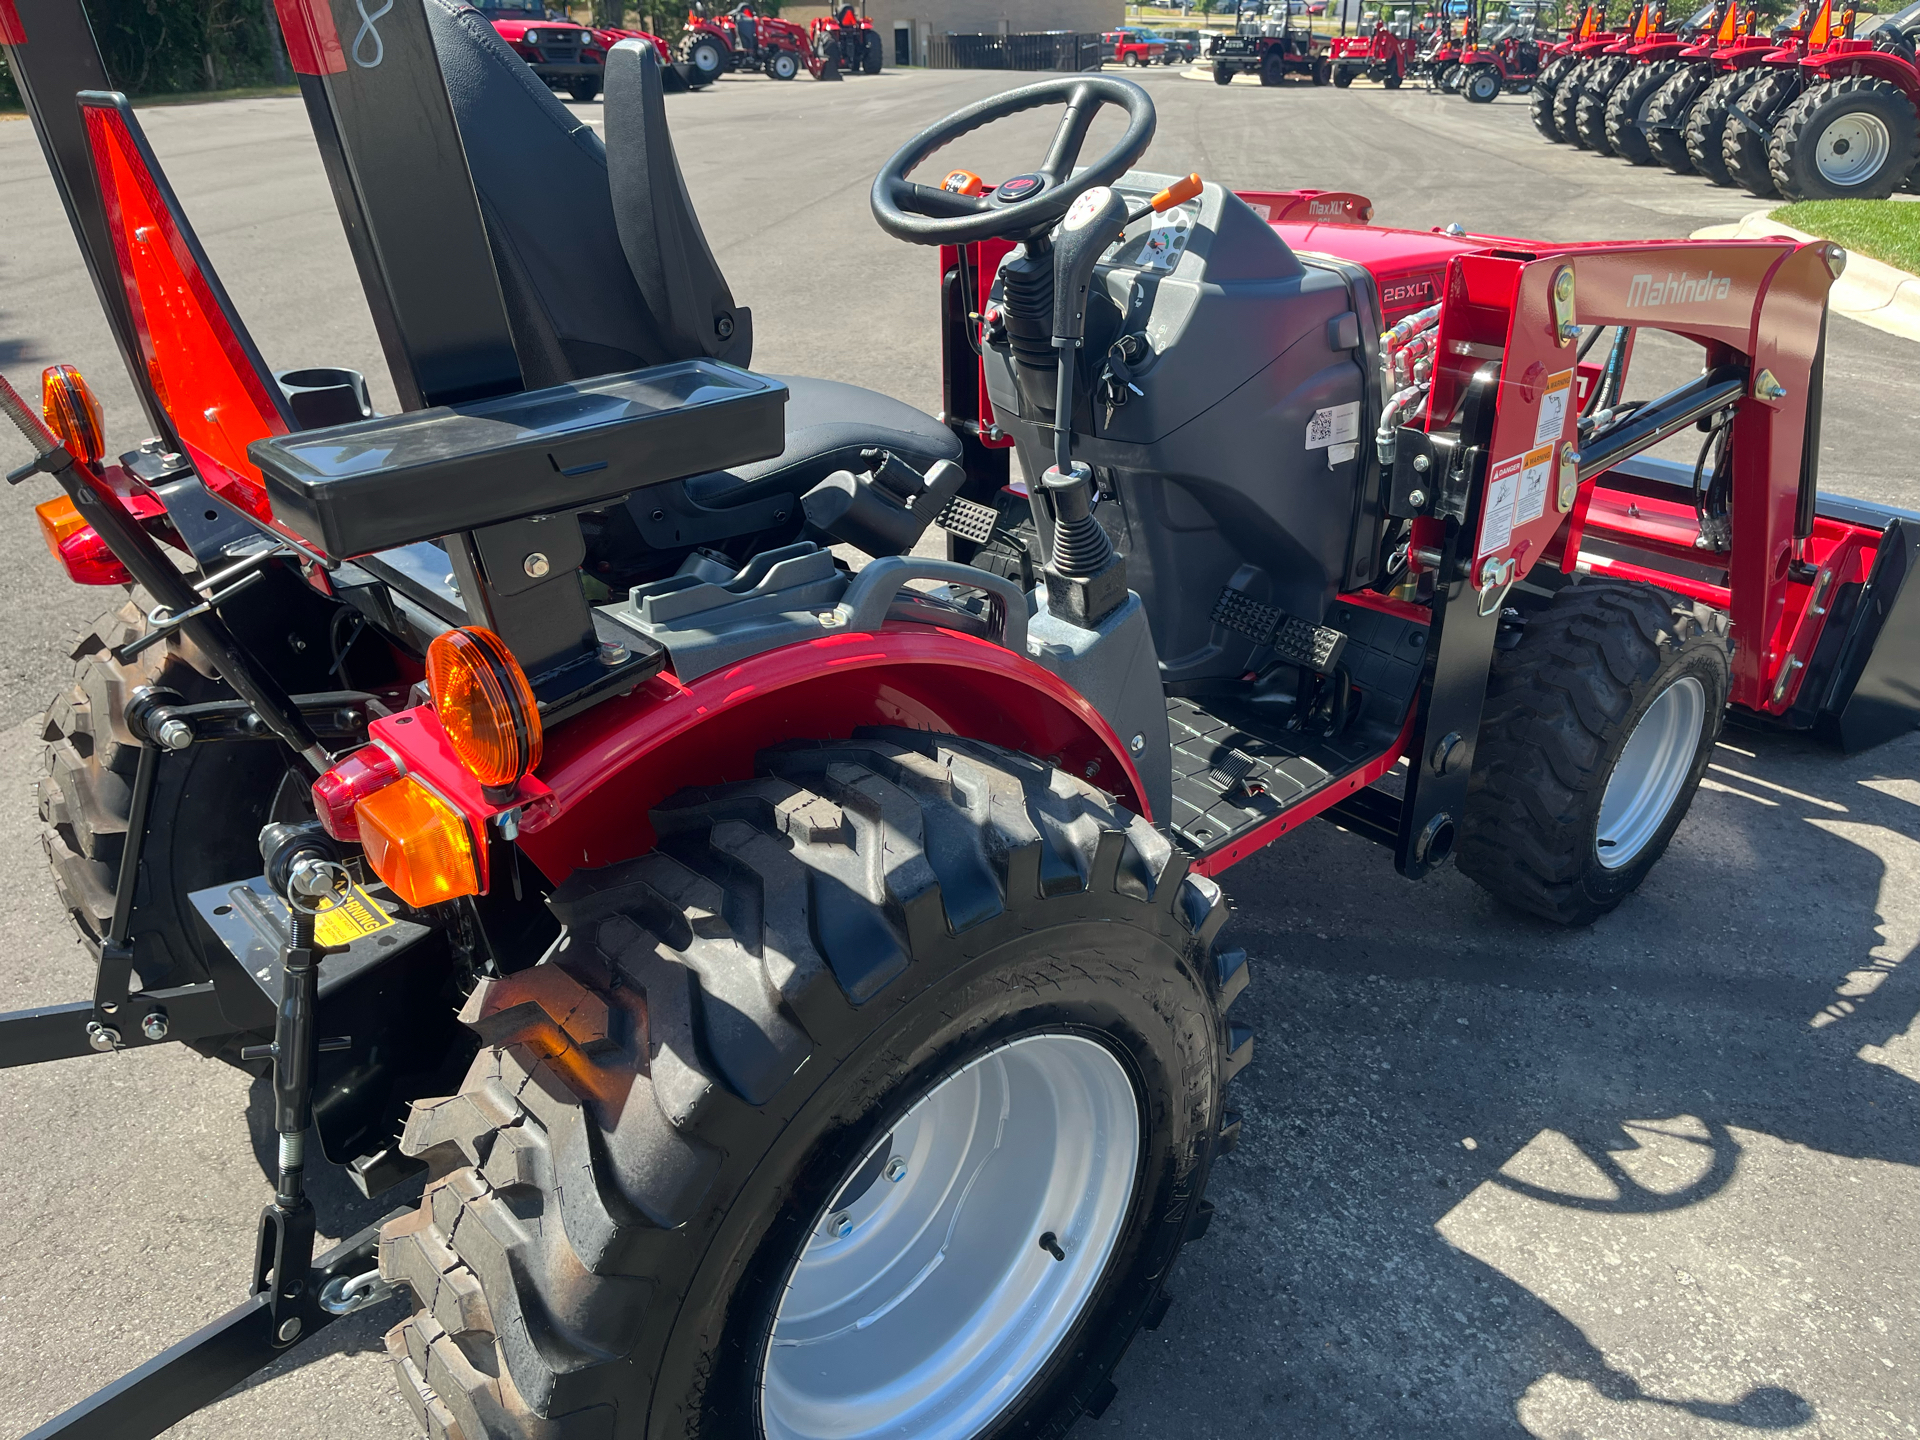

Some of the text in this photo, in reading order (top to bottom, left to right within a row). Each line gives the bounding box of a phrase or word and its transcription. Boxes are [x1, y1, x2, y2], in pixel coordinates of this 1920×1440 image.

[1308, 200, 1345, 215] MaxXLT
[1383, 280, 1431, 303] 26XLT
[1626, 270, 1731, 308] Mahindra
[1550, 376, 1571, 389] WARNING
[1529, 451, 1551, 465] WARNING
[1498, 462, 1521, 477] DANGER
